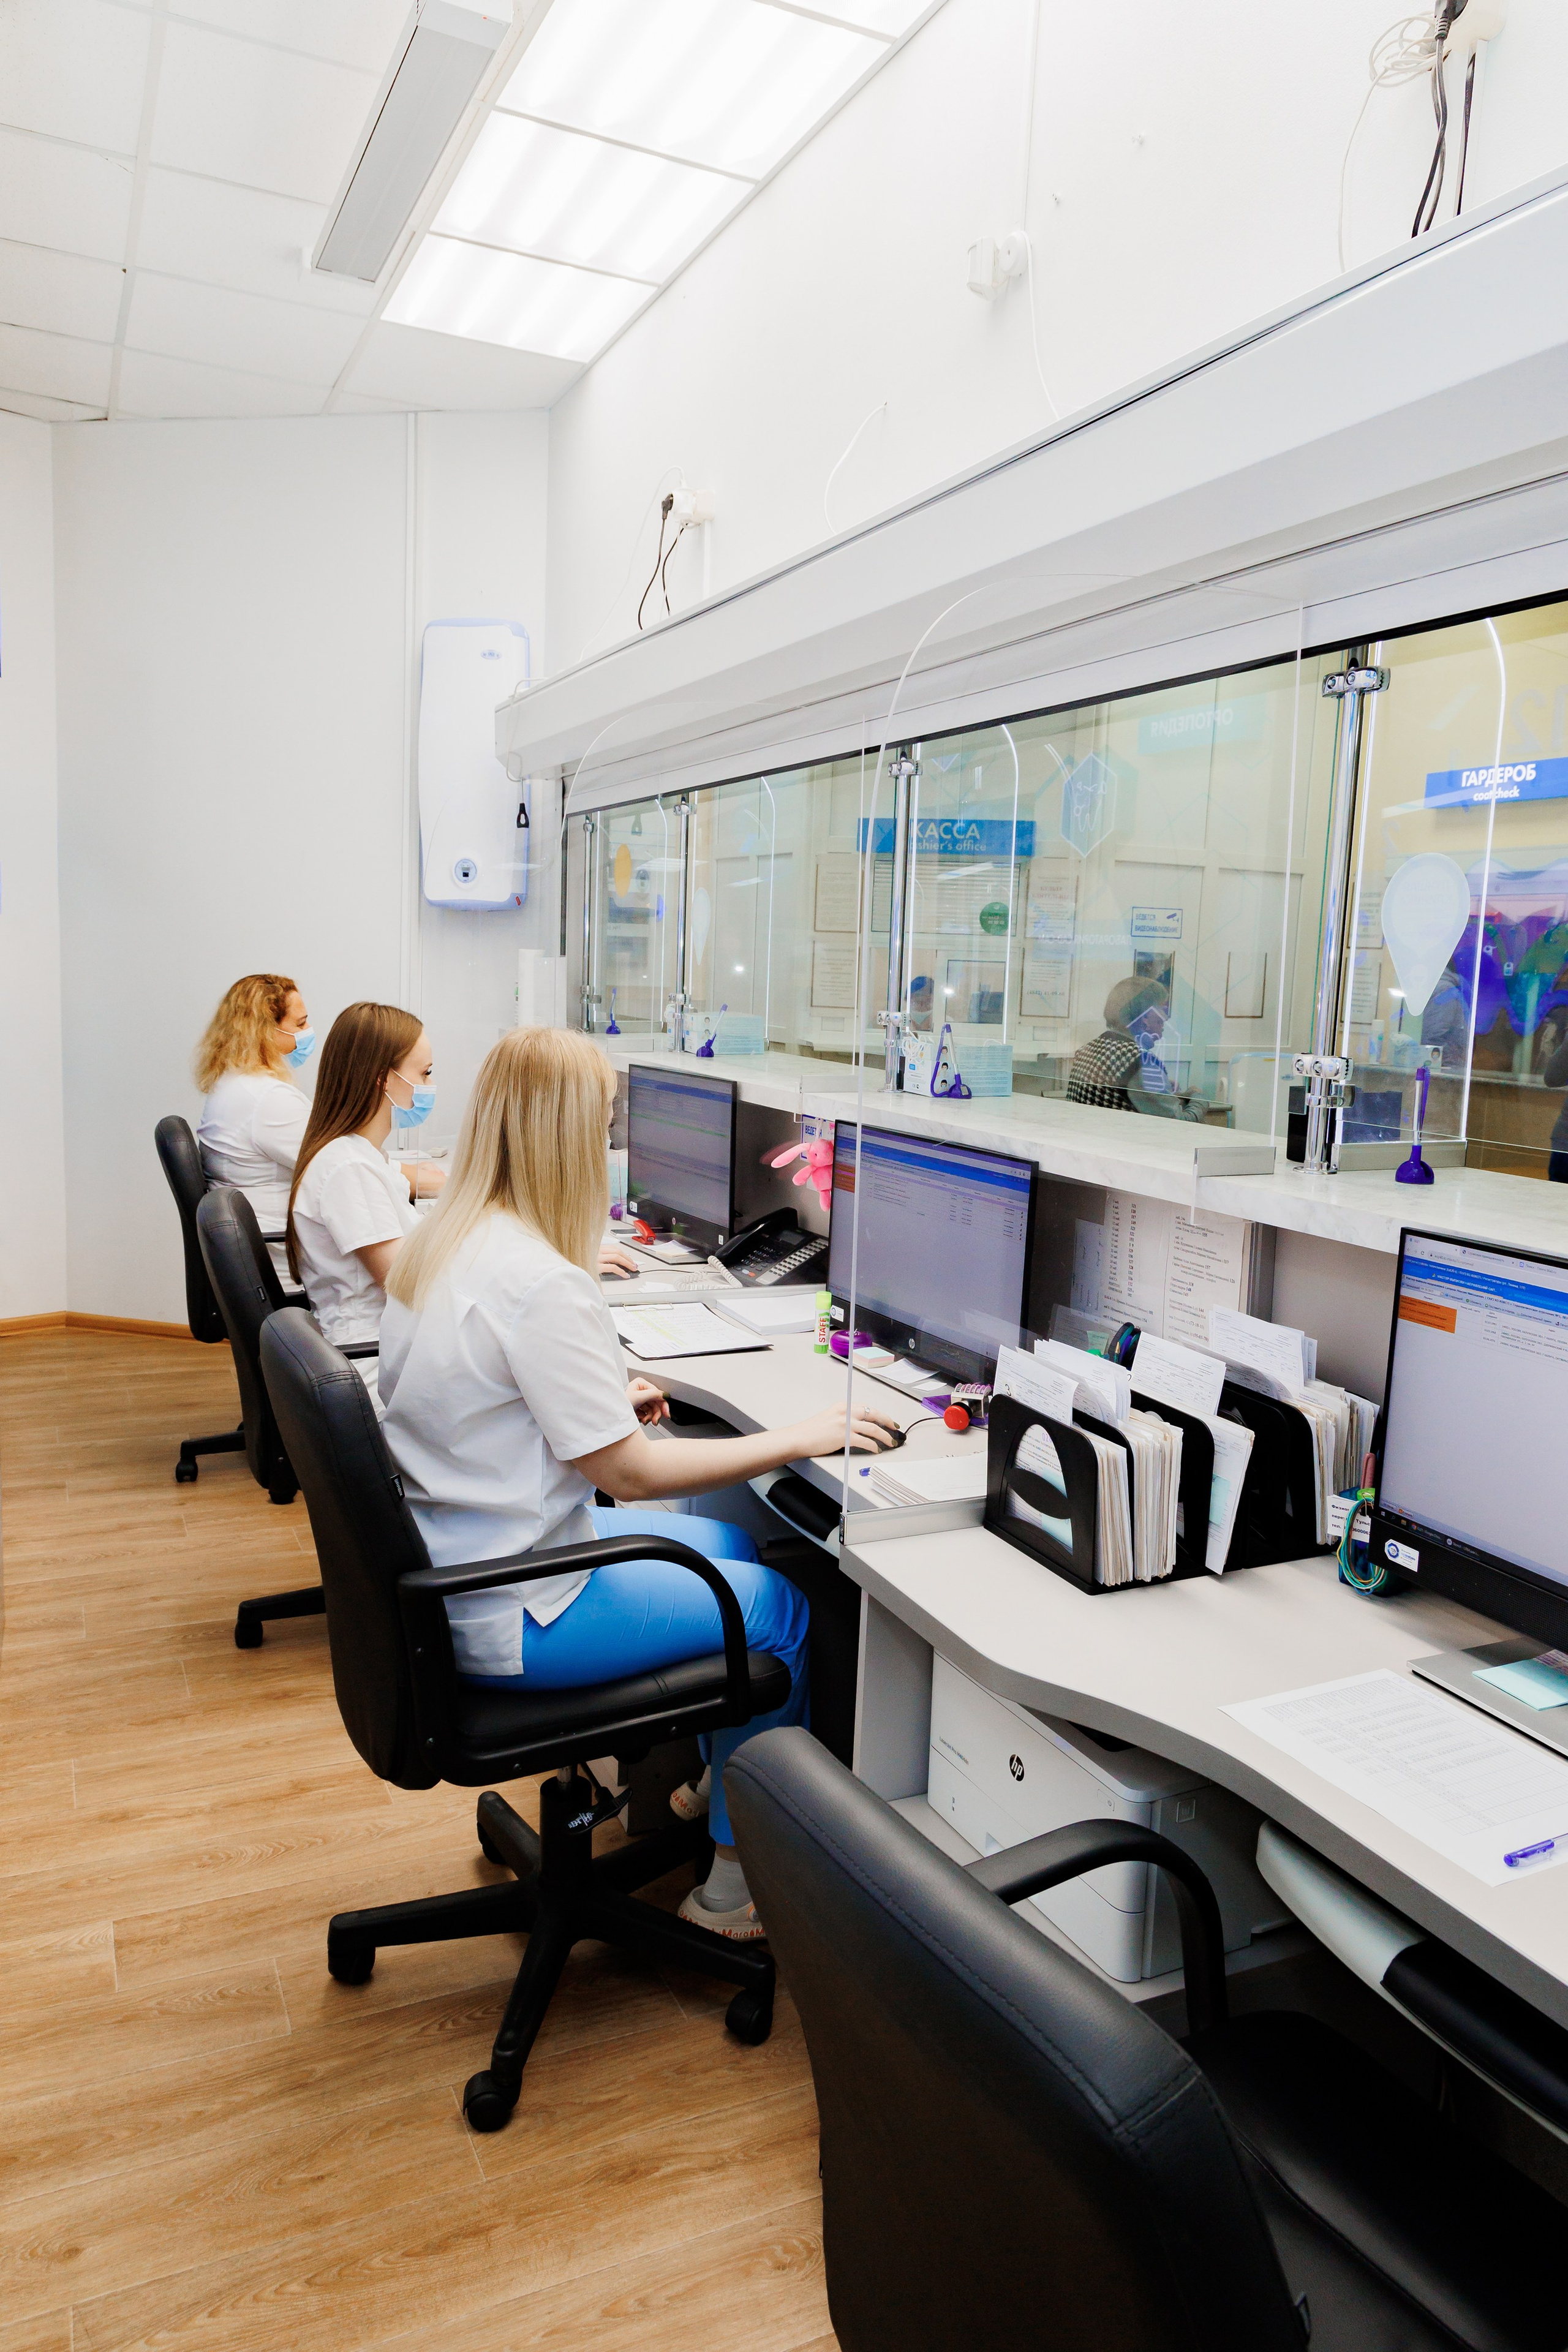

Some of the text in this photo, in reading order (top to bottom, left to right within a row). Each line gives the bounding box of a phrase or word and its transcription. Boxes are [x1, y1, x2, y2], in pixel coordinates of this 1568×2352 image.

[1461, 764, 1536, 788] ГАРДЕРОБ
[956, 839, 986, 851] office
[805, 1125, 823, 1137] ВЕДЕТЯ
[939, 1736, 951, 1751] LaserJet
[1011, 1755, 1023, 1781] hp
